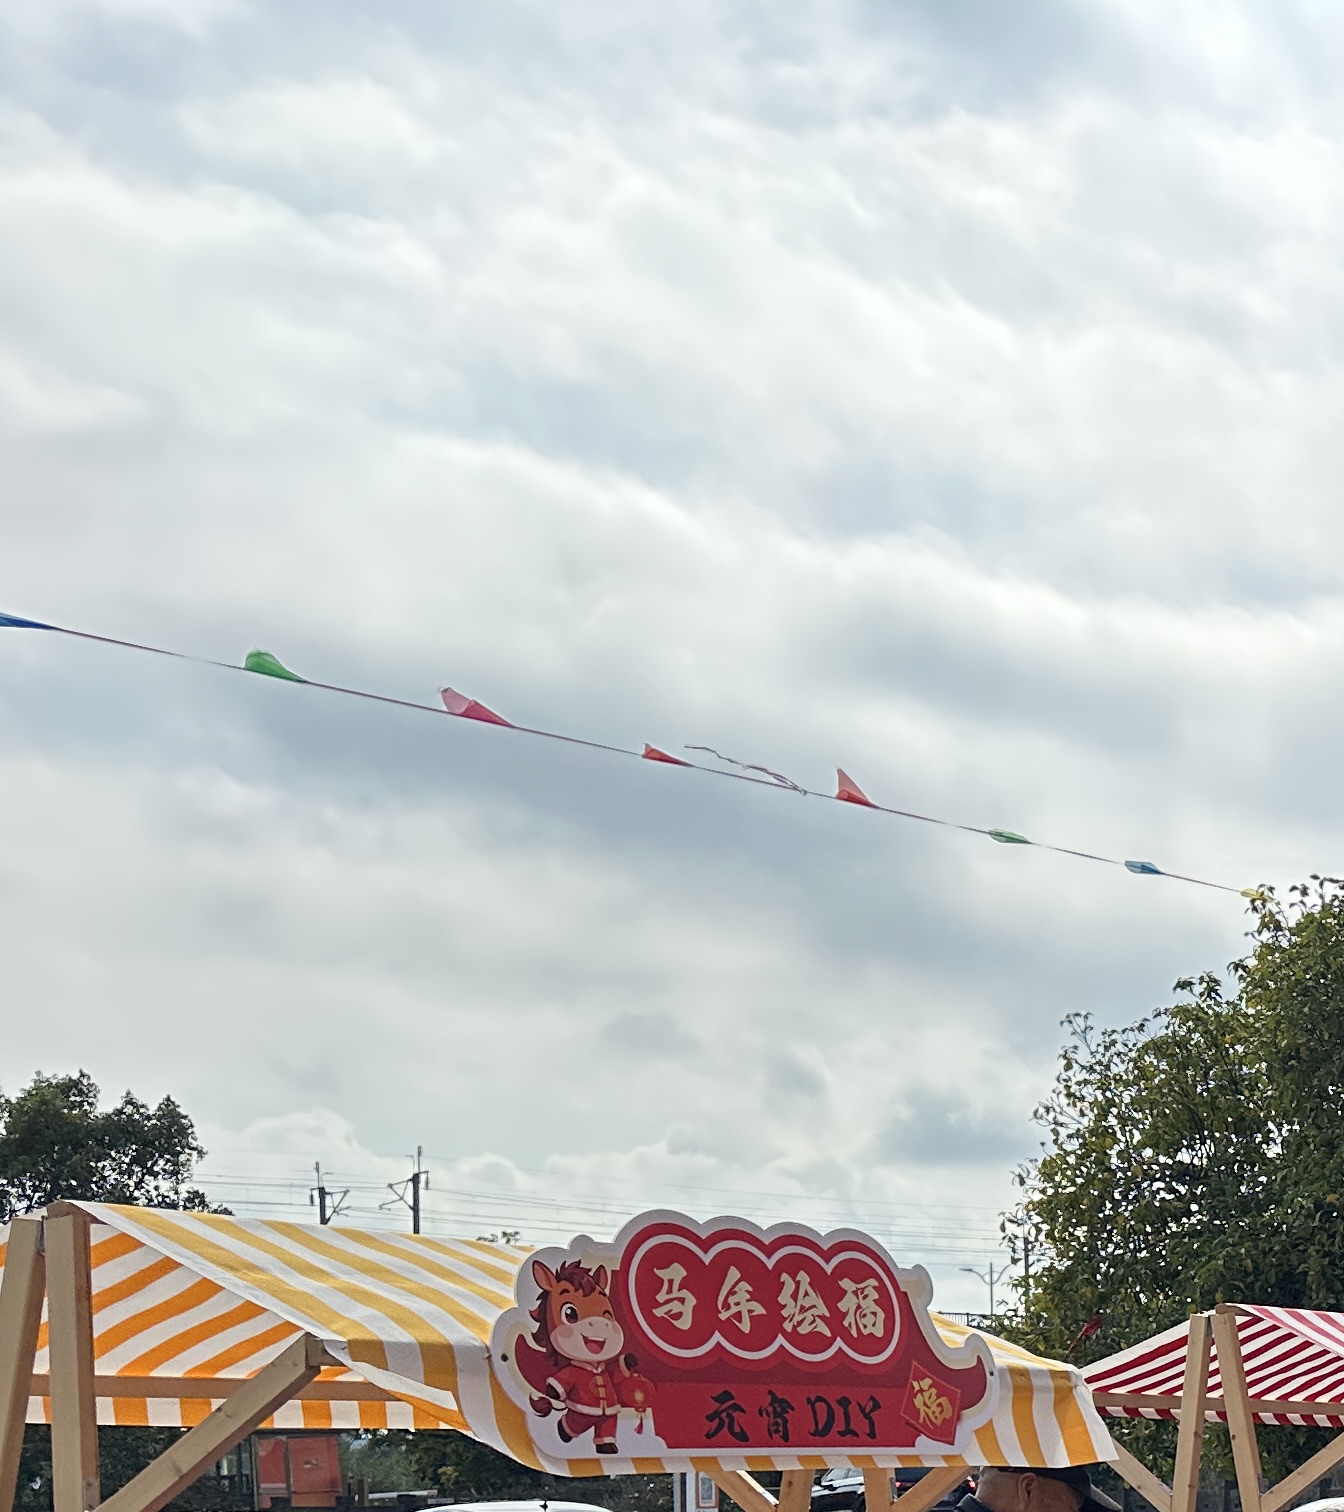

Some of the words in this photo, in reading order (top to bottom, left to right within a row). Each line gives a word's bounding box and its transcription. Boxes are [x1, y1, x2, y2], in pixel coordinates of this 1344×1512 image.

[652, 1262, 886, 1340] 马年绘福
[911, 1379, 954, 1430] 福
